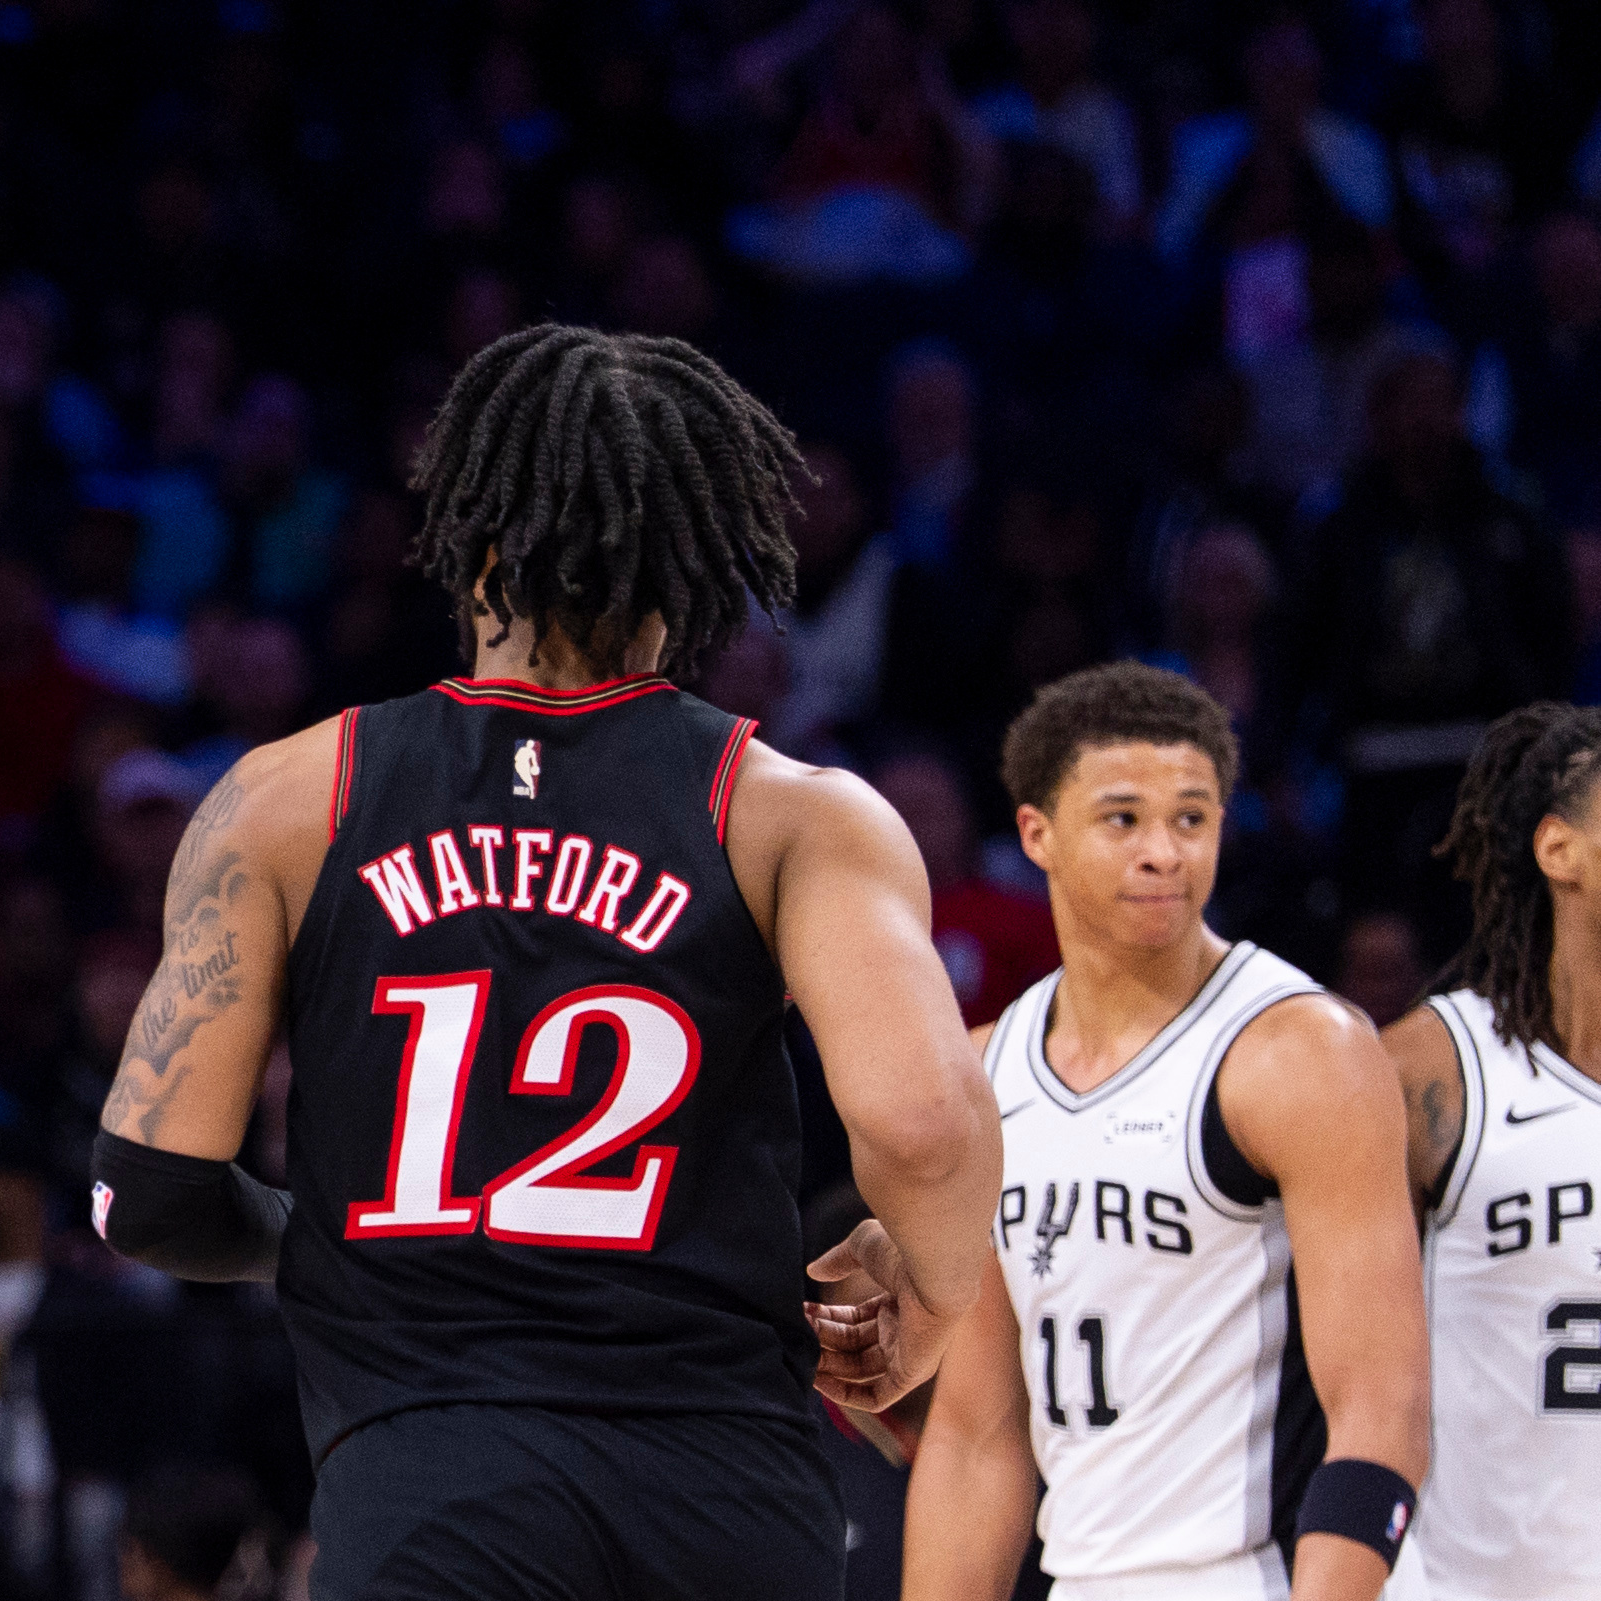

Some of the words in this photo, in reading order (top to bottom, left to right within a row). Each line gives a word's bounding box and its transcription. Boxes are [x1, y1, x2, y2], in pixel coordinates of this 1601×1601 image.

[359, 825, 691, 953] WATFORD
[182, 930, 240, 1000] limit
[344, 969, 701, 1251] 12
[999, 1179, 1194, 1278] PURS
[1485, 1180, 1601, 1264] SP
[1035, 1310, 1124, 1438] 11
